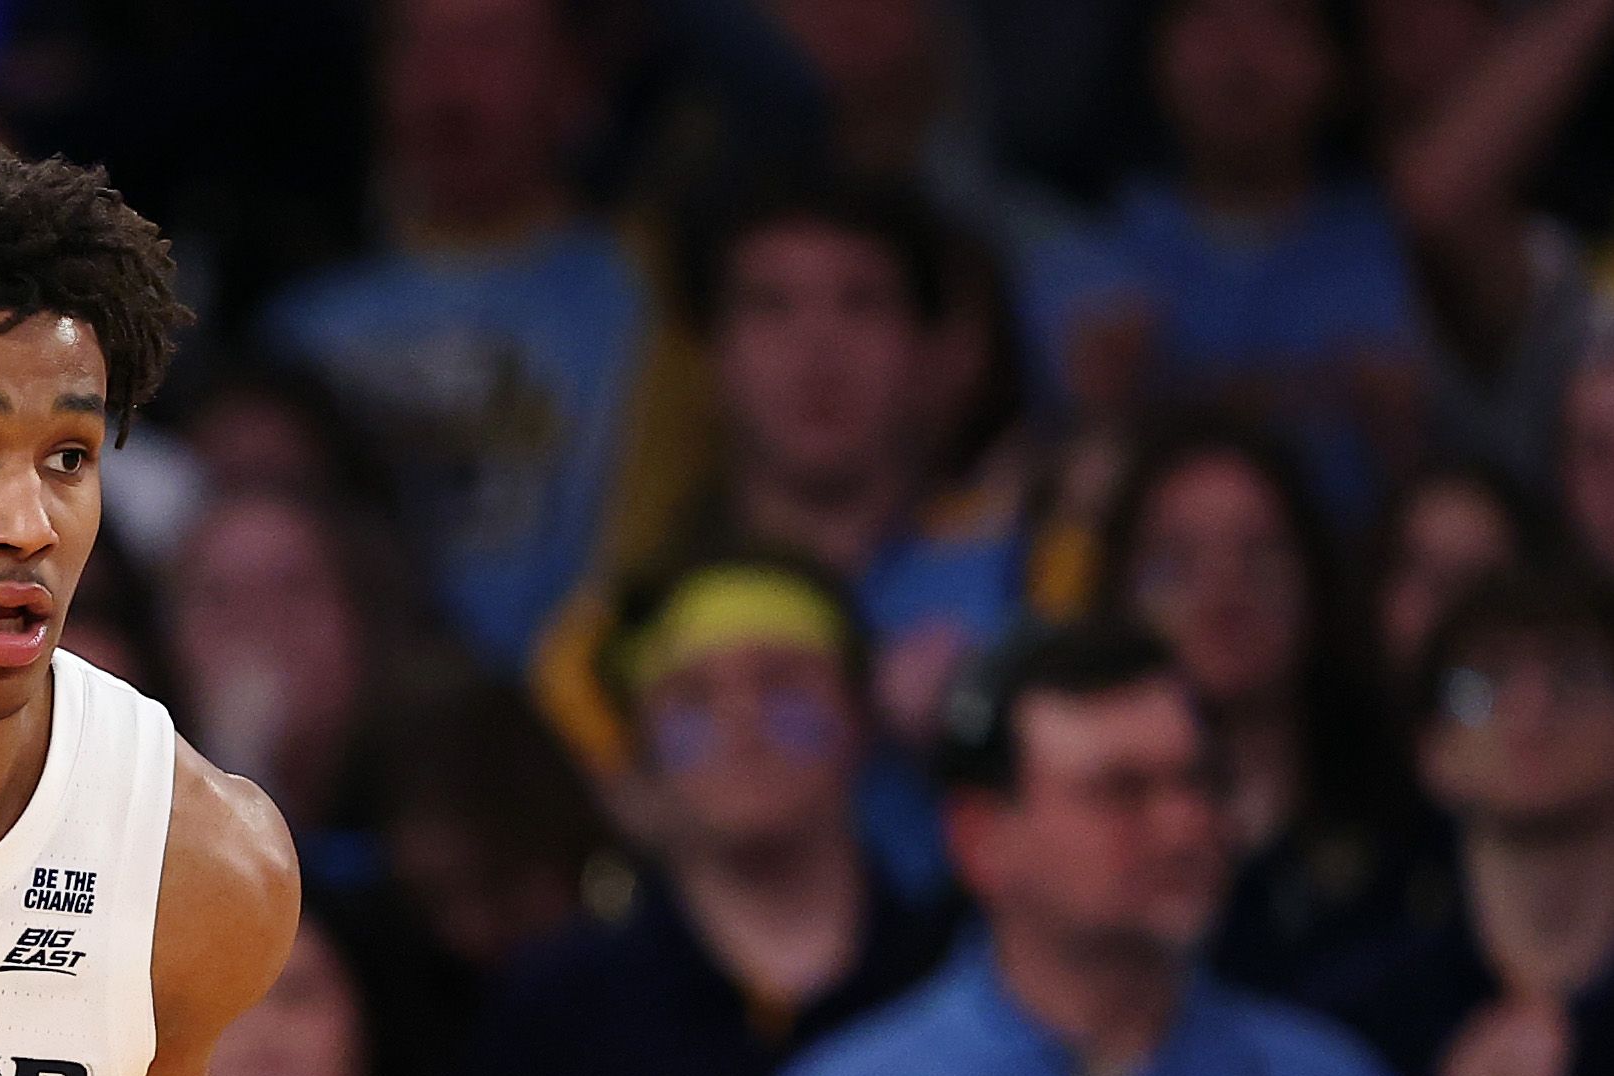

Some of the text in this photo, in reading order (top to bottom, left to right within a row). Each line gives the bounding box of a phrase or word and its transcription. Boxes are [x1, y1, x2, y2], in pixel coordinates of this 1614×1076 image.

[32, 867, 97, 892] BE THE
[24, 888, 95, 914] CHANGE
[16, 927, 76, 948] BIG
[3, 946, 86, 968] EAST
